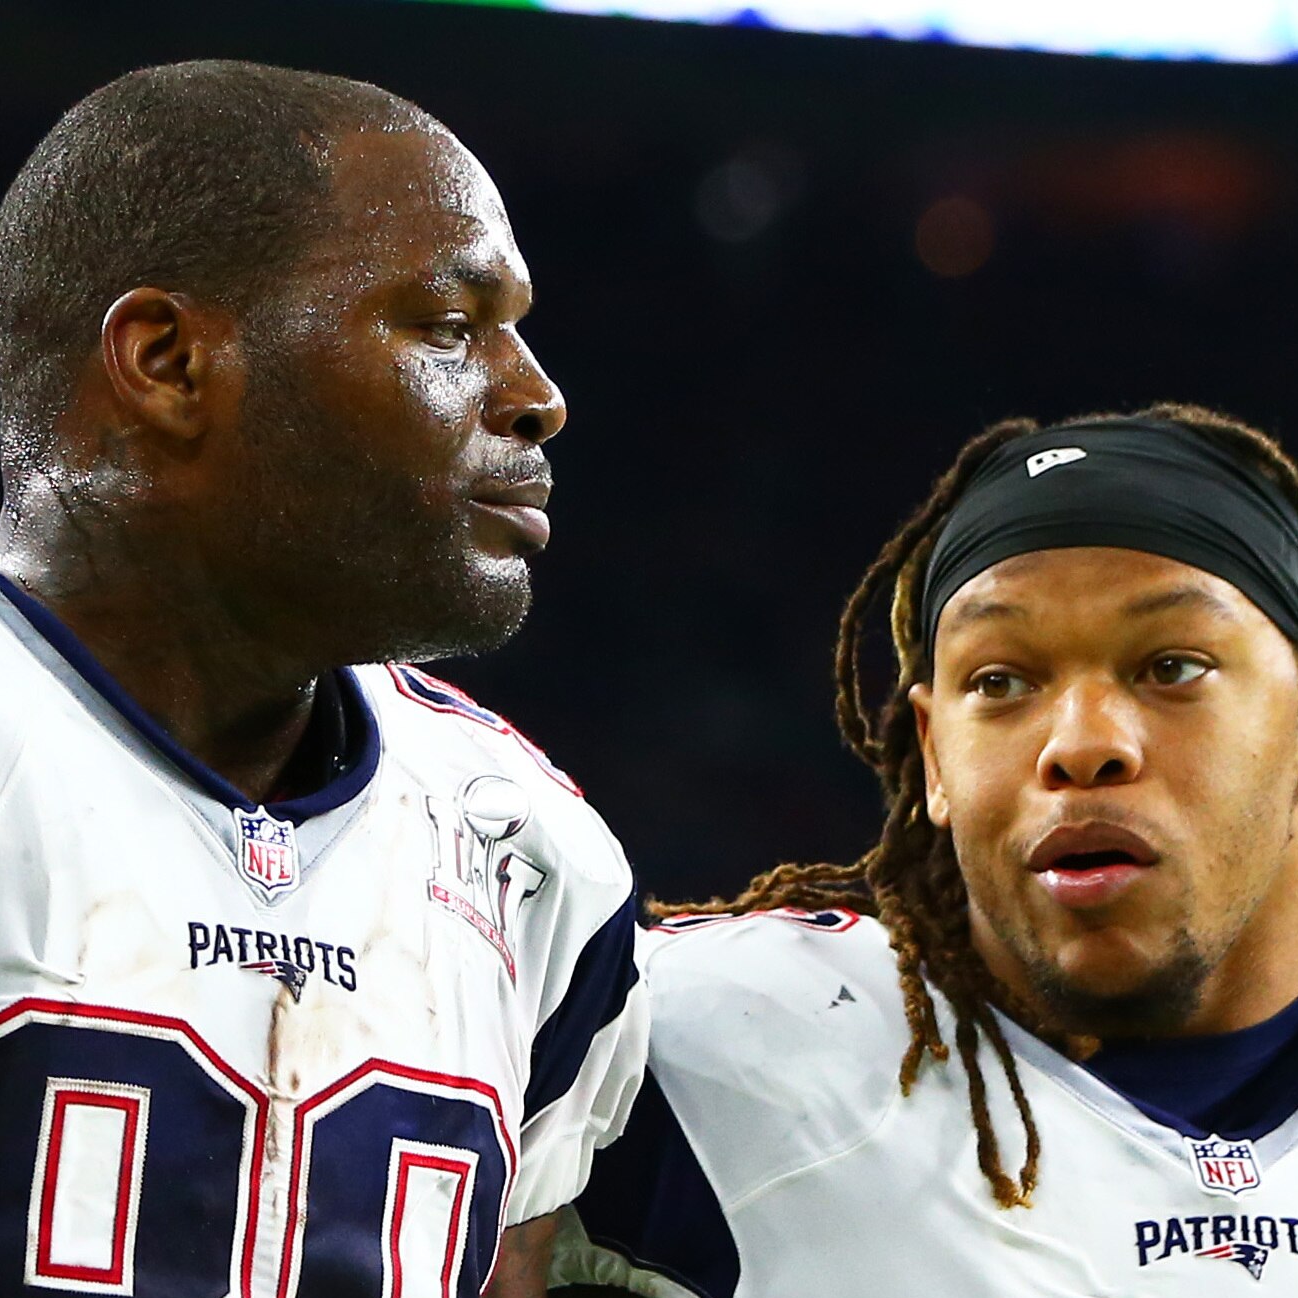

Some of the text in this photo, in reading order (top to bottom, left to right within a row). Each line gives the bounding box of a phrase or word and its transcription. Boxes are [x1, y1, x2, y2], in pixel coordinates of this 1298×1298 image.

[247, 841, 292, 882] NFL
[187, 920, 358, 993] PATRIOTS
[1203, 1160, 1255, 1188] NFL
